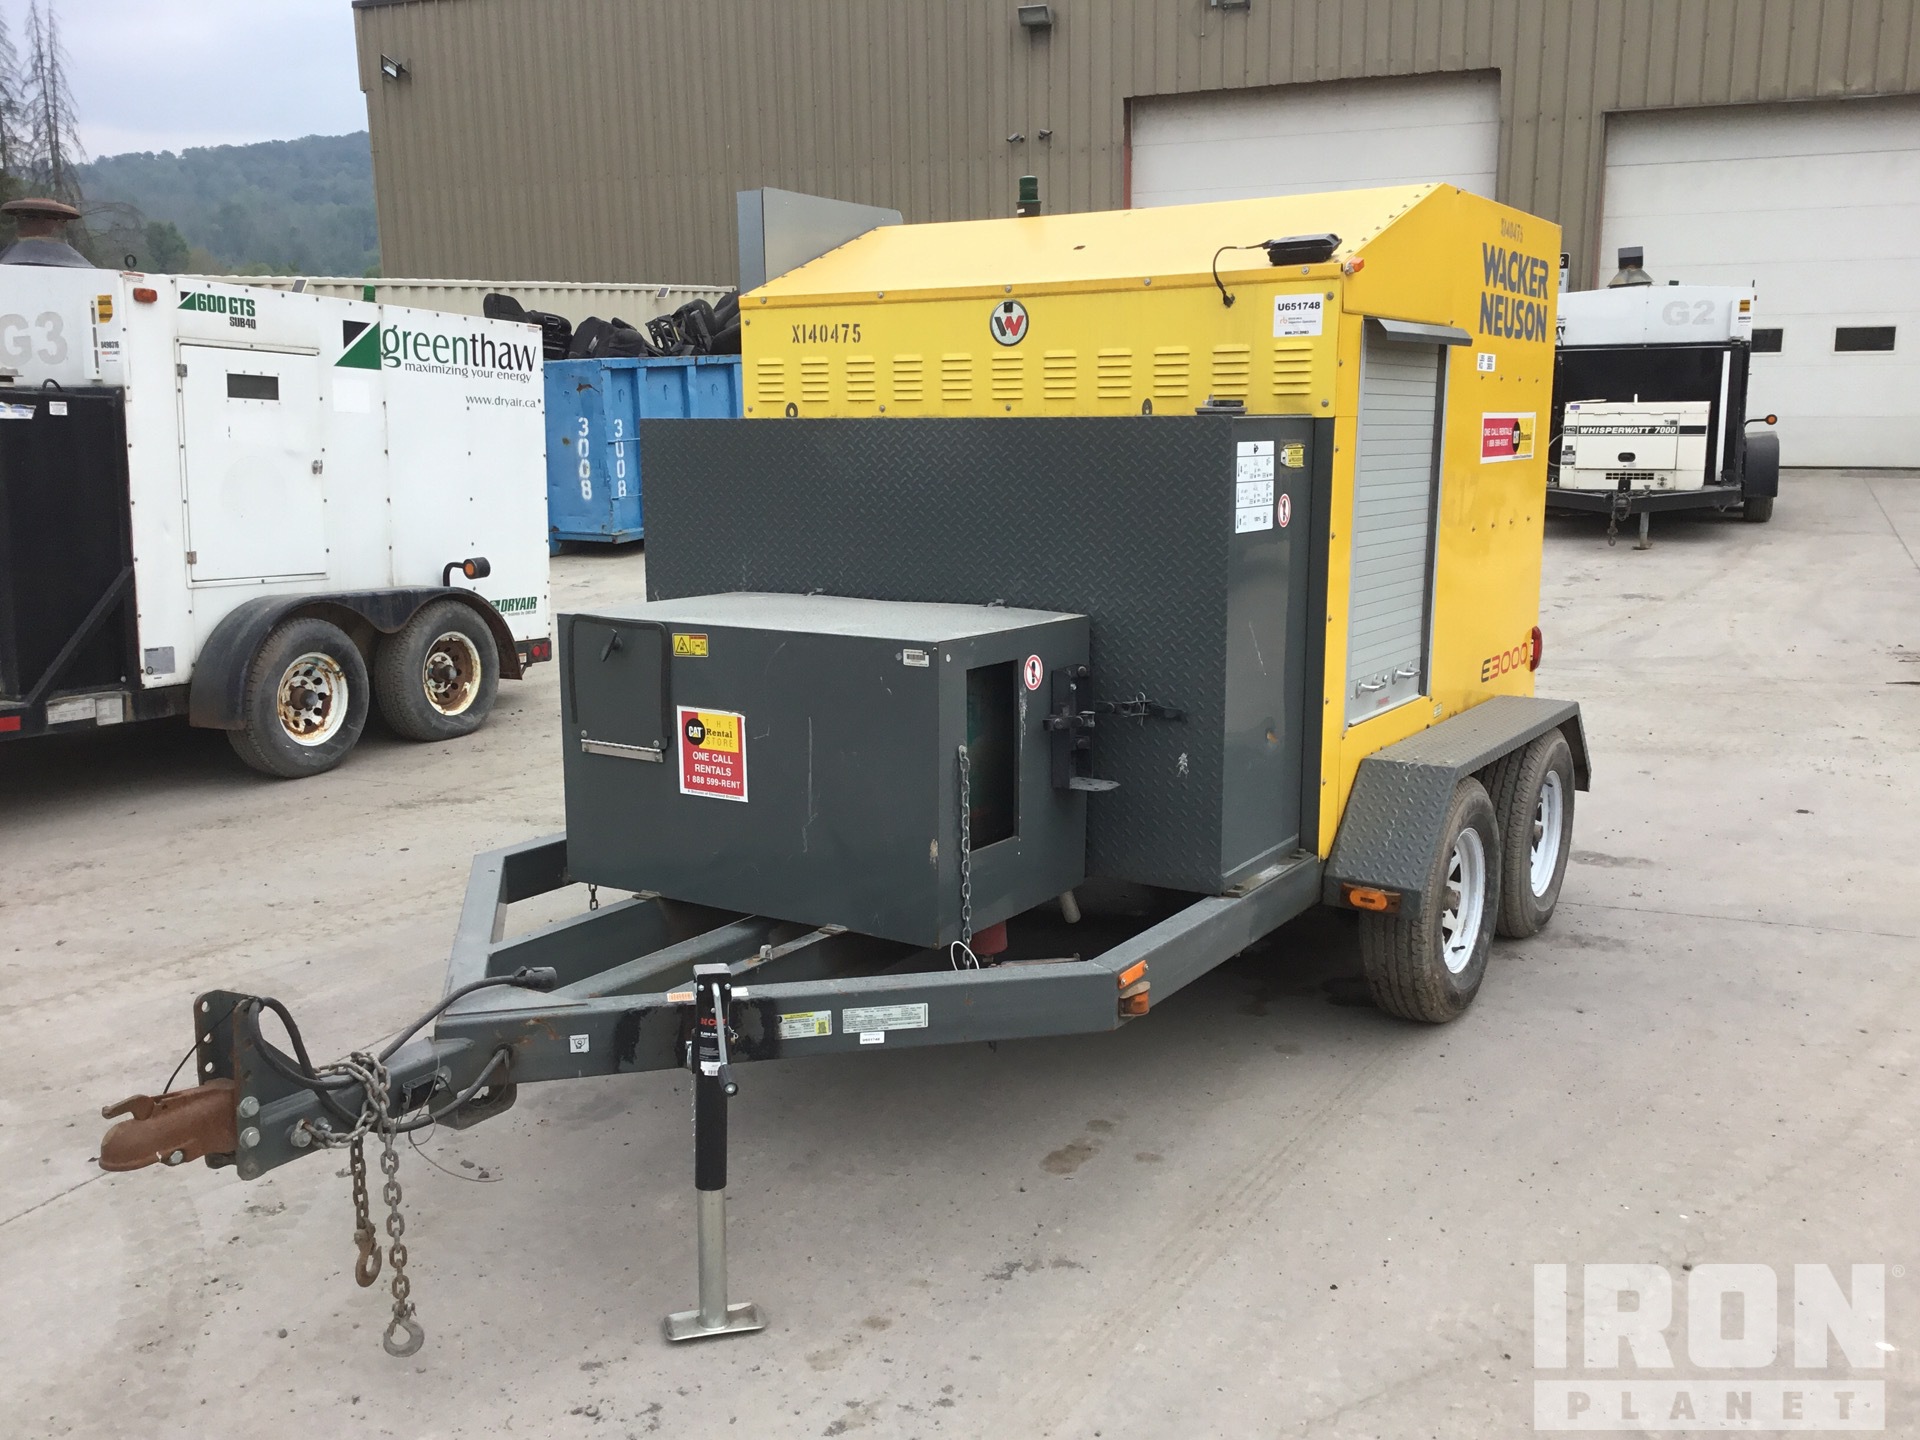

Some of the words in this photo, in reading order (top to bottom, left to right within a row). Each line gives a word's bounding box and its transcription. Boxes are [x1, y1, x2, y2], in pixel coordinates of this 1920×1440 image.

[1482, 242, 1549, 300] WACKER
[197, 293, 226, 313] 600
[229, 297, 256, 317] GTS
[1277, 301, 1321, 311] U651748
[1662, 300, 1716, 326] G2
[1479, 291, 1548, 343] NEUSON
[0, 311, 68, 366] G3
[382, 325, 537, 372] greenthaw
[405, 362, 469, 379] maximizing
[471, 369, 494, 380] your
[497, 372, 532, 384] energy
[465, 395, 537, 409] www.dryair.ca
[1580, 426, 1650, 434] WHISPERWATT
[1654, 426, 1677, 434] 7000
[578, 416, 593, 501] 3008
[613, 418, 627, 497] 3008
[500, 596, 538, 613] DRYAIR
[1481, 642, 1528, 683] E3000
[688, 725, 703, 738] CAT
[706, 728, 733, 738] Rental
[706, 737, 734, 748] STORE
[692, 751, 710, 761] ONE
[712, 754, 734, 764] CALL
[694, 763, 732, 777] RENTALS
[686, 774, 691, 782] 1
[692, 775, 705, 784] 888
[706, 777, 741, 789] 599-RENT
